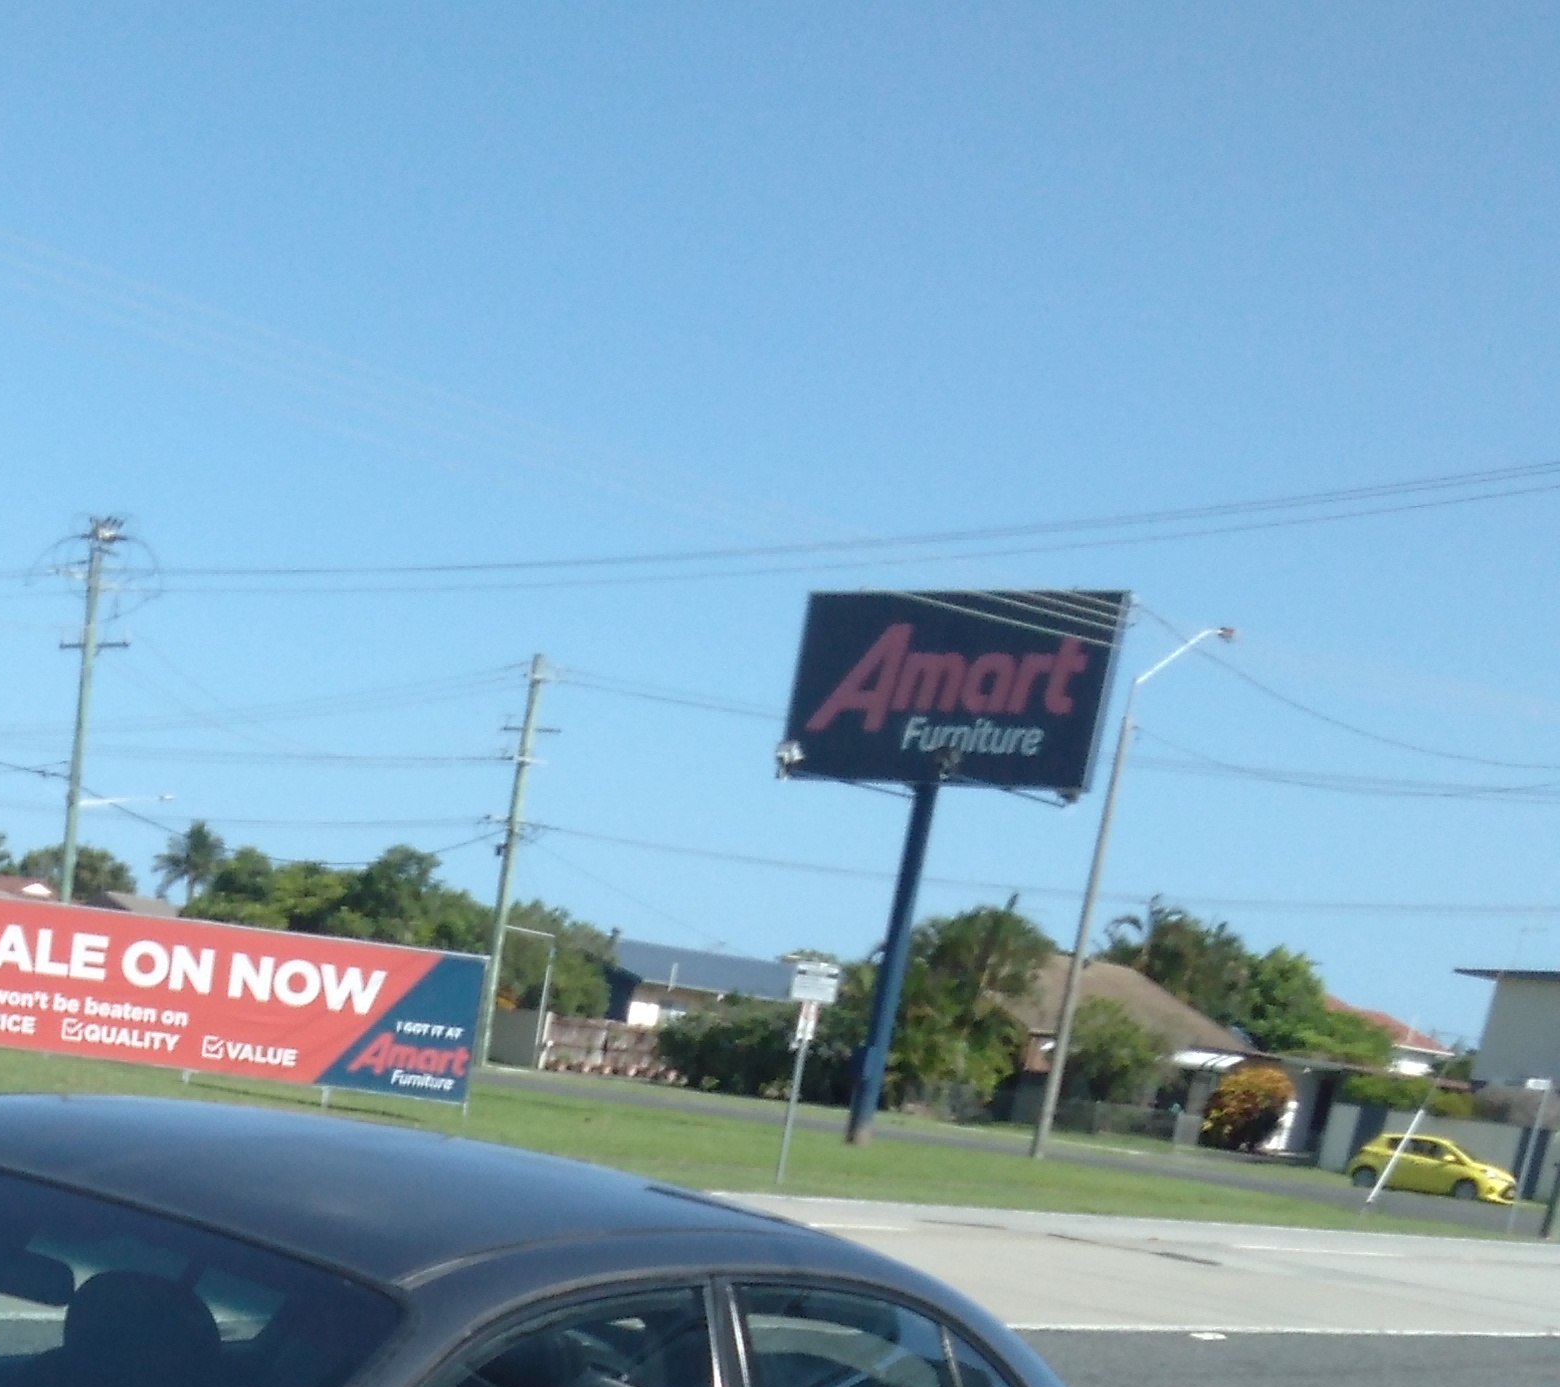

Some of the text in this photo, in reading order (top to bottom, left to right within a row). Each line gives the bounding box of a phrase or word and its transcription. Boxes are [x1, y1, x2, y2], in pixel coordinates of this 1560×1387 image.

[805, 622, 1088, 733] Amart
[900, 715, 1044, 757] Furniture
[122, 939, 216, 995] ON
[227, 952, 387, 1015] NOW
[53, 993, 80, 1012] be
[84, 997, 156, 1023] beaten
[161, 1010, 188, 1026] on
[84, 1024, 181, 1052] QUALITY
[403, 1022, 431, 1036] GOT
[431, 1025, 445, 1038] IT
[445, 1027, 464, 1040] AT
[225, 1041, 298, 1067] VALUE
[346, 1031, 472, 1077] Amart
[391, 1069, 455, 1091] Furniture
